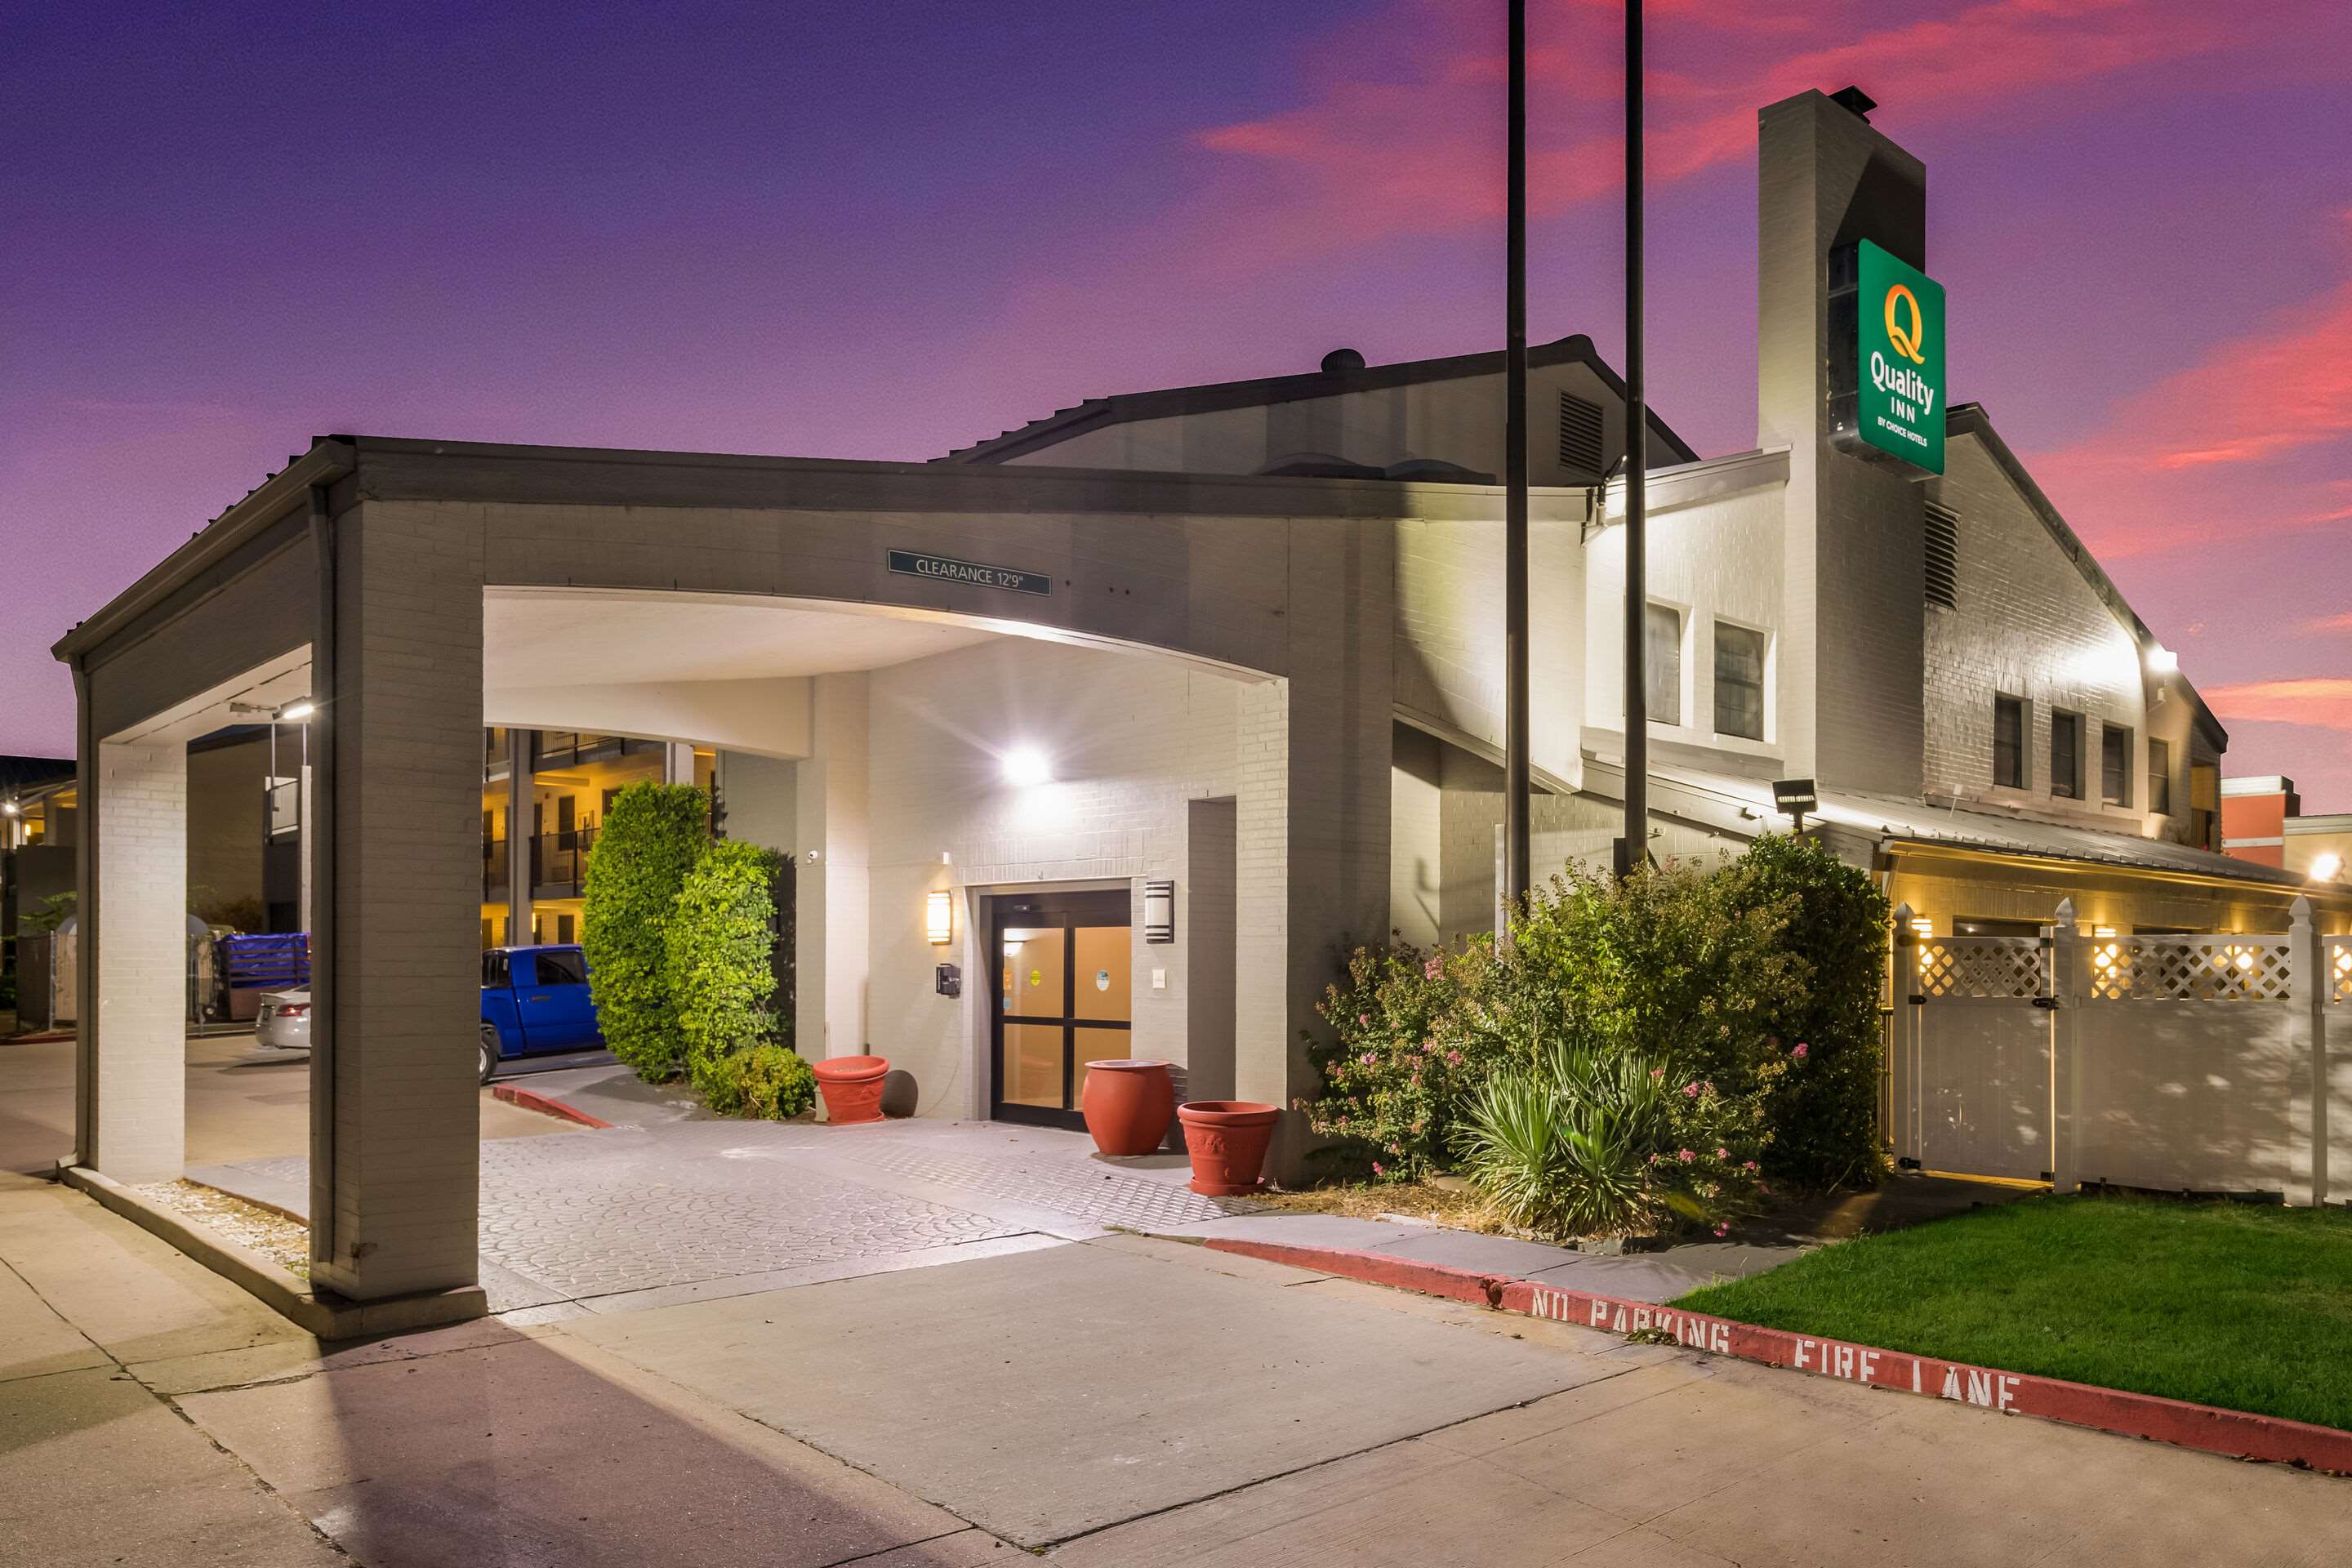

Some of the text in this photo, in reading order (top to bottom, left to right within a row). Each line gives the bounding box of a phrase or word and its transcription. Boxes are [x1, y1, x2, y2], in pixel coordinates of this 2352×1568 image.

[1885, 284, 1925, 364] Q
[1870, 351, 1935, 416] Quality
[1878, 416, 1927, 447] BY CHOICE HOTELS
[1891, 396, 1915, 424] INN
[915, 559, 993, 584] CLEARANCE
[1532, 1288, 1569, 1322] NO
[1589, 1298, 1730, 1353] PARKING
[1794, 1339, 1881, 1382] FIRE
